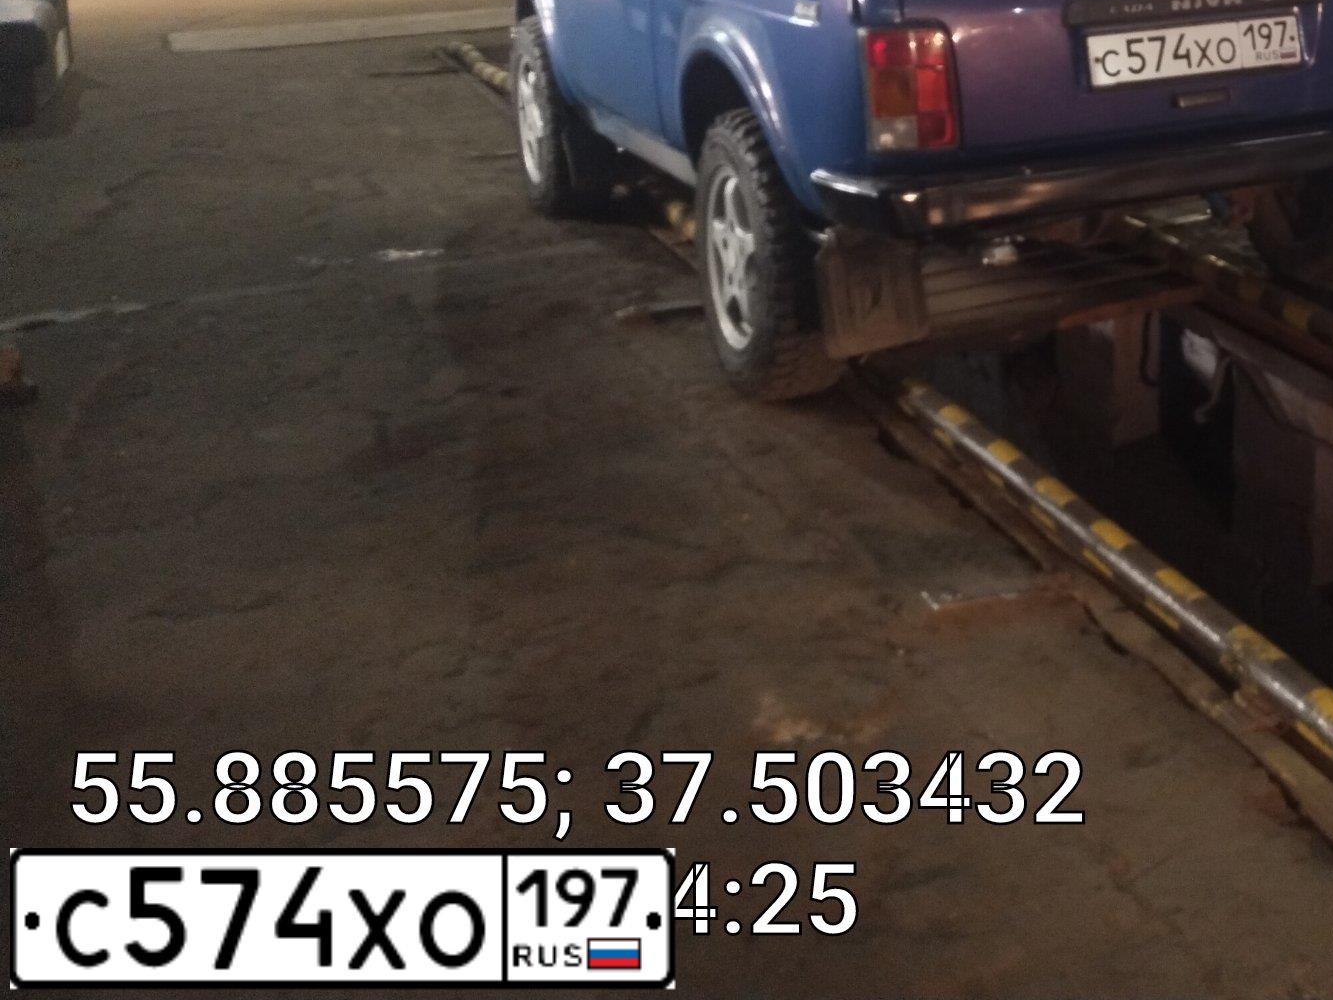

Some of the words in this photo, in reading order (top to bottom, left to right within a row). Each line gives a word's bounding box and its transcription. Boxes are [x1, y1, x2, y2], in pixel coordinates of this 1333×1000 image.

[1101, 32, 1237, 77] С574ХО
[1242, 20, 1288, 51] 197
[1254, 51, 1280, 62] RUS
